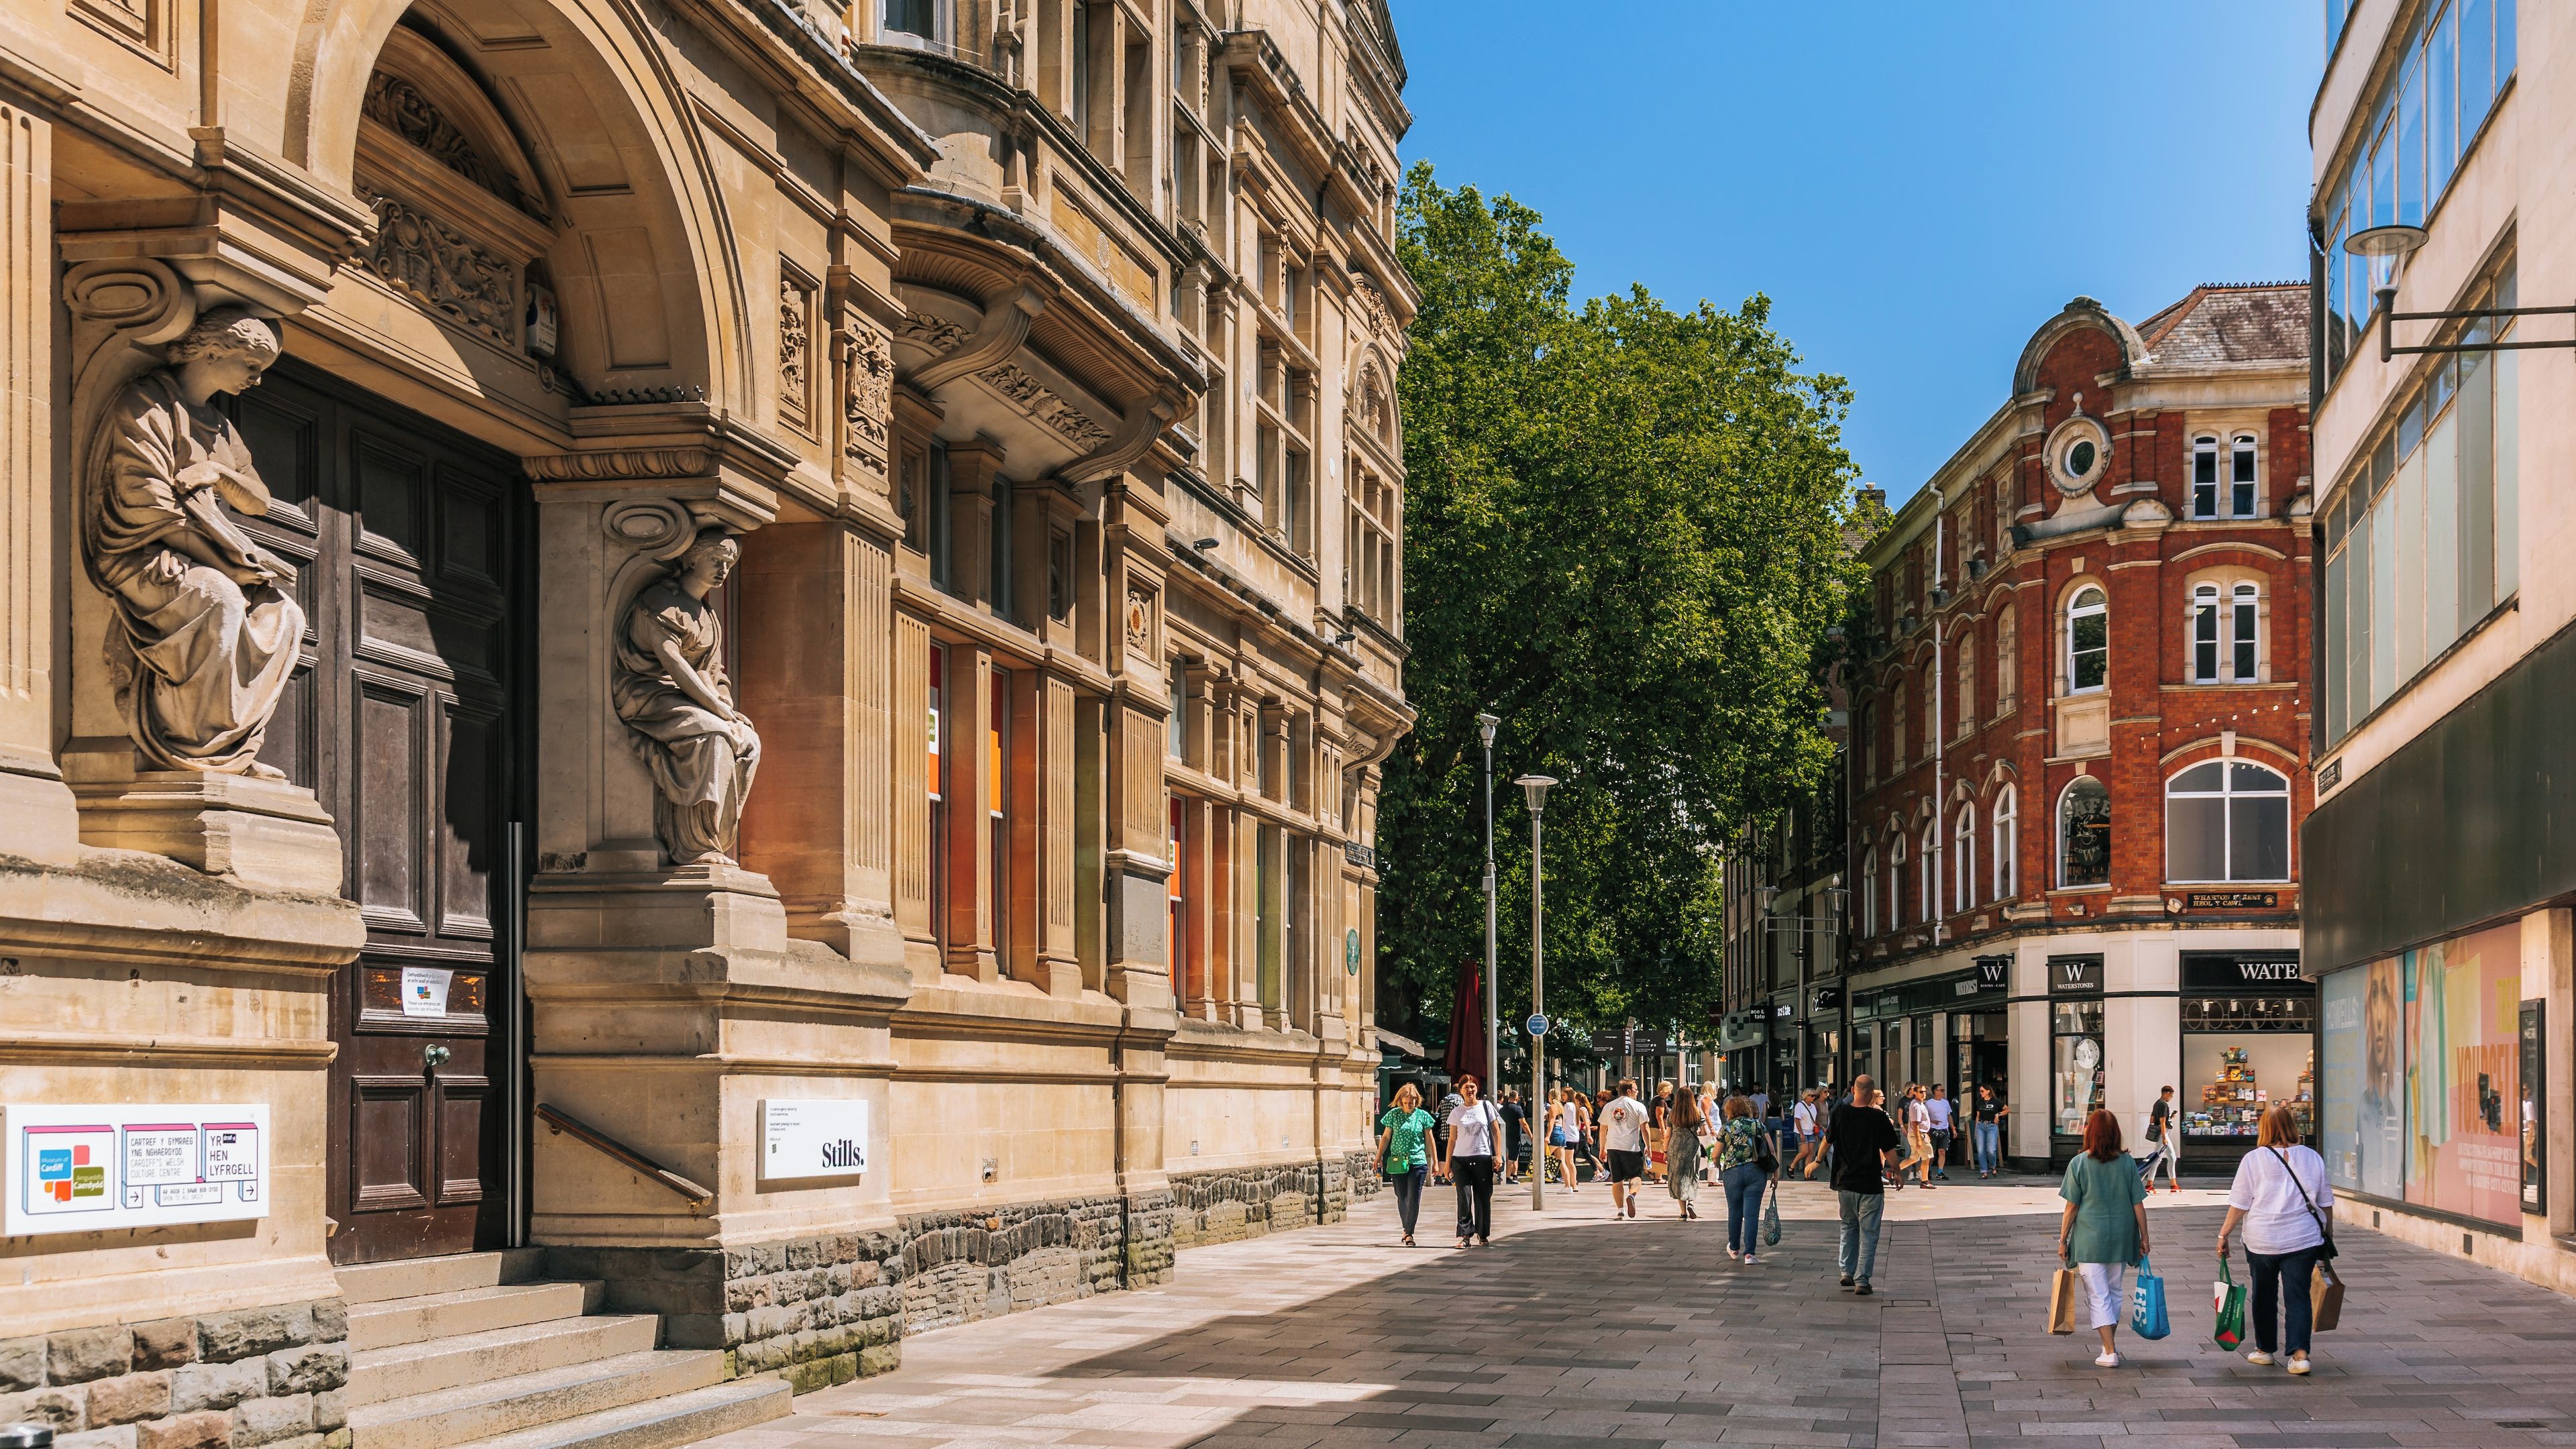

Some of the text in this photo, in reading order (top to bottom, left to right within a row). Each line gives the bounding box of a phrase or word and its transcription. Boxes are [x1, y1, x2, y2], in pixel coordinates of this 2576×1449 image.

[2074, 798, 2110, 818] AFE
[1982, 965, 2003, 981] W
[2065, 963, 2086, 981] W
[2238, 963, 2300, 979] WATE
[130, 1137, 193, 1146] CARTREF Y GYMRAEG
[210, 1135, 222, 1146] YR
[130, 1148, 182, 1157] YNG NGHAERDYDD
[209, 1150, 228, 1161] HEN
[822, 1138, 865, 1169] Stills.
[41, 1163, 64, 1172] Cardiff
[130, 1158, 184, 1168] CARDIFF'S WELSH
[130, 1168, 181, 1178] CULTURE CENTRE
[209, 1163, 254, 1176] LYFRGELL
[74, 1181, 103, 1191] Caerdydd
